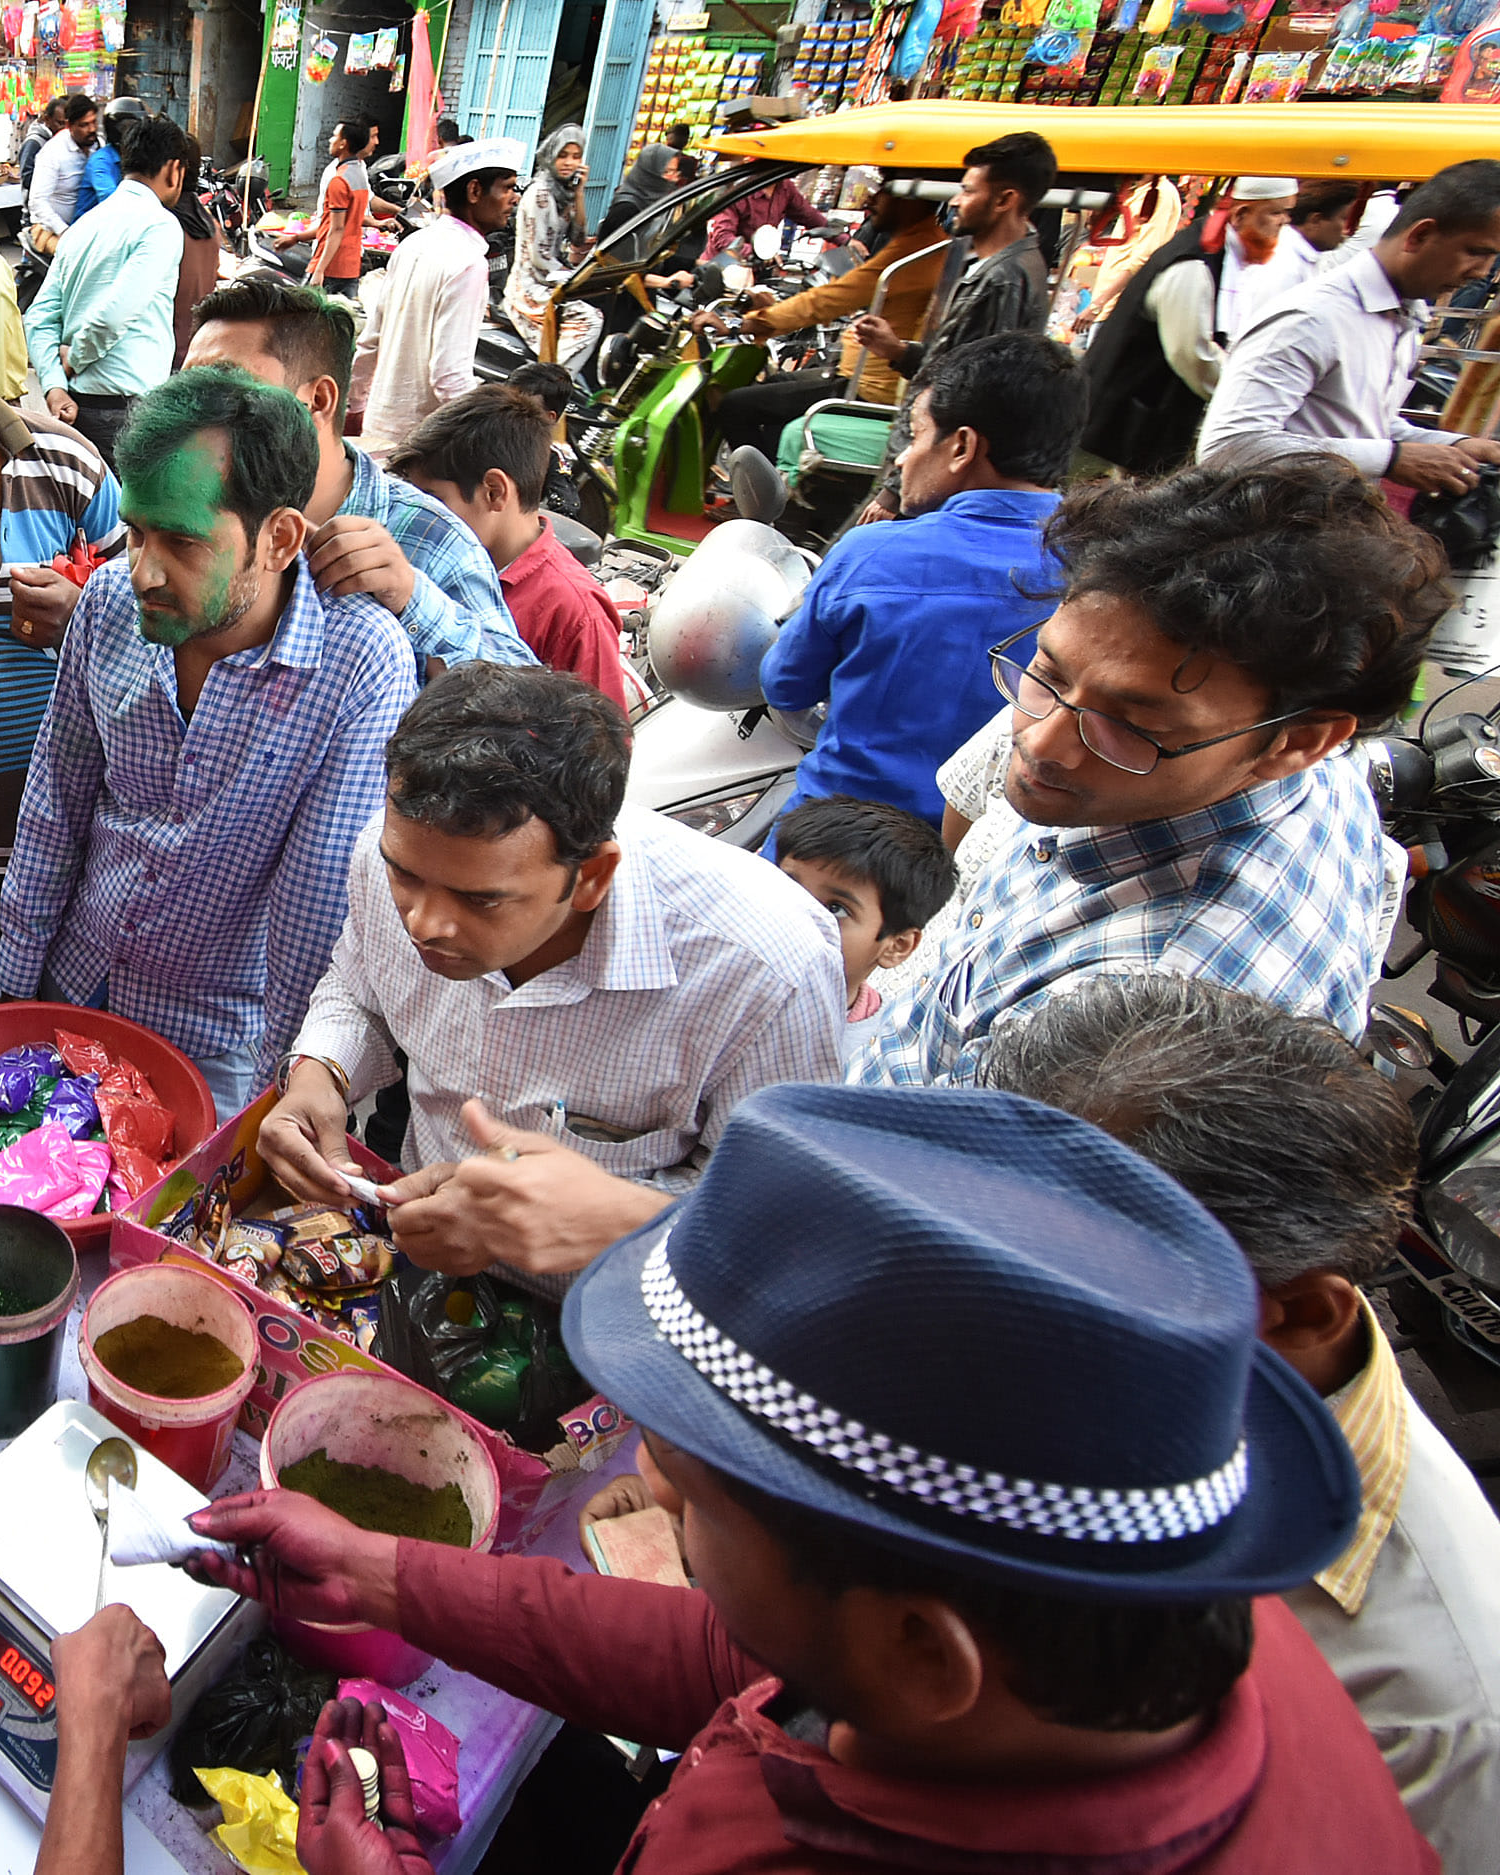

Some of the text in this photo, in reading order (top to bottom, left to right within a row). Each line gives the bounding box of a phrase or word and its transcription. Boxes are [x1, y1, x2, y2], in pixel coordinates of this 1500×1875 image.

[0, 1647, 56, 1708] 0.092
[4, 1734, 50, 1781] WEIGHING SCALE
